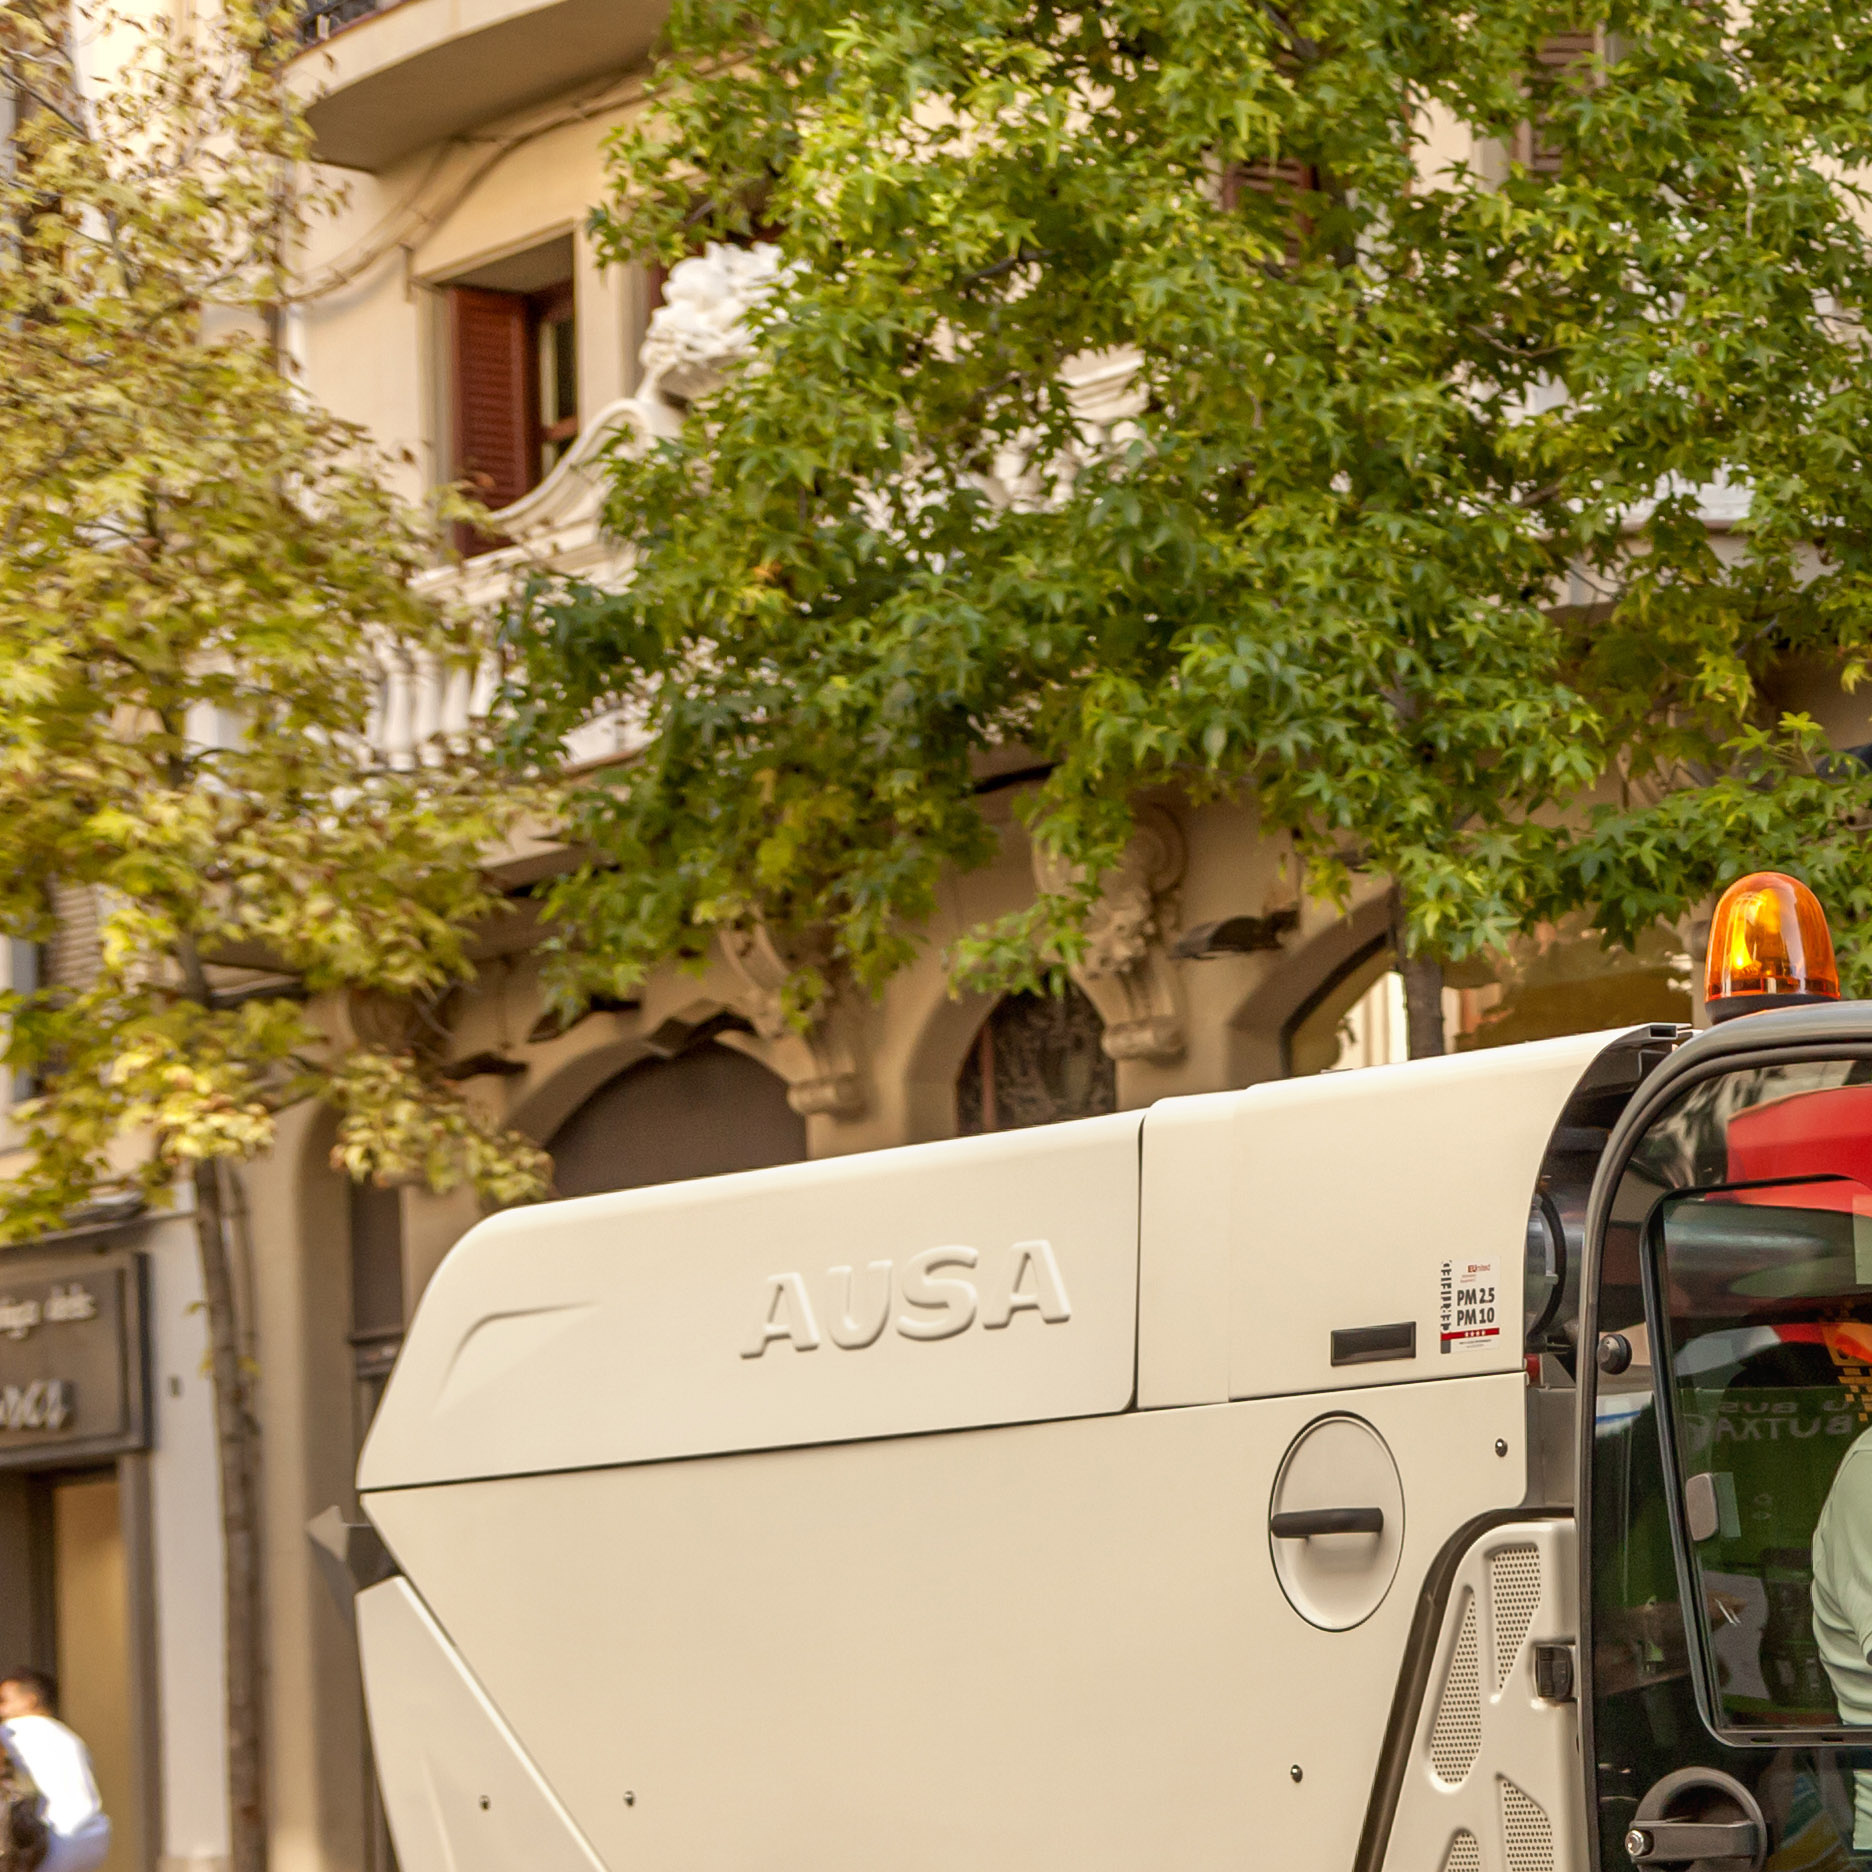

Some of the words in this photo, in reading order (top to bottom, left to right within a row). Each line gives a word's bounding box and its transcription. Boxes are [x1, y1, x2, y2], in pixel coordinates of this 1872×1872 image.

[740, 1239, 1071, 1360] AUSA
[1457, 1288, 1477, 1306] PM
[1457, 1308, 1477, 1326] PM
[1479, 1307, 1495, 1324] 10
